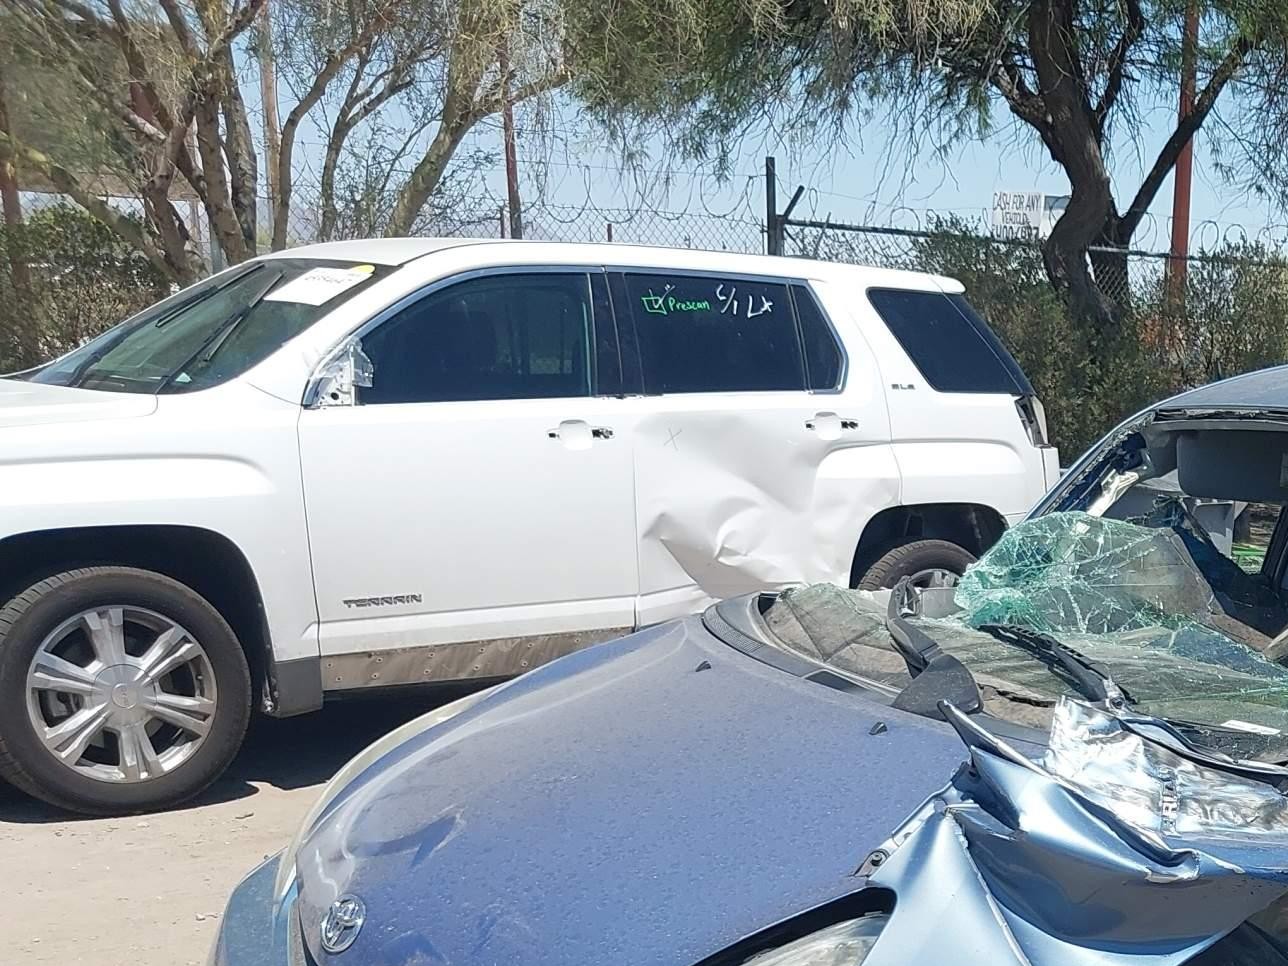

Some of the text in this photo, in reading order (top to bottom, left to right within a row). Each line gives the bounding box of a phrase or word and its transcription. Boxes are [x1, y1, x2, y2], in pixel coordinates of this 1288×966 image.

[992, 192, 1041, 212] CASH FOR ANY
[667, 296, 711, 312] Prescan
[342, 594, 423, 608] TERRAIN
